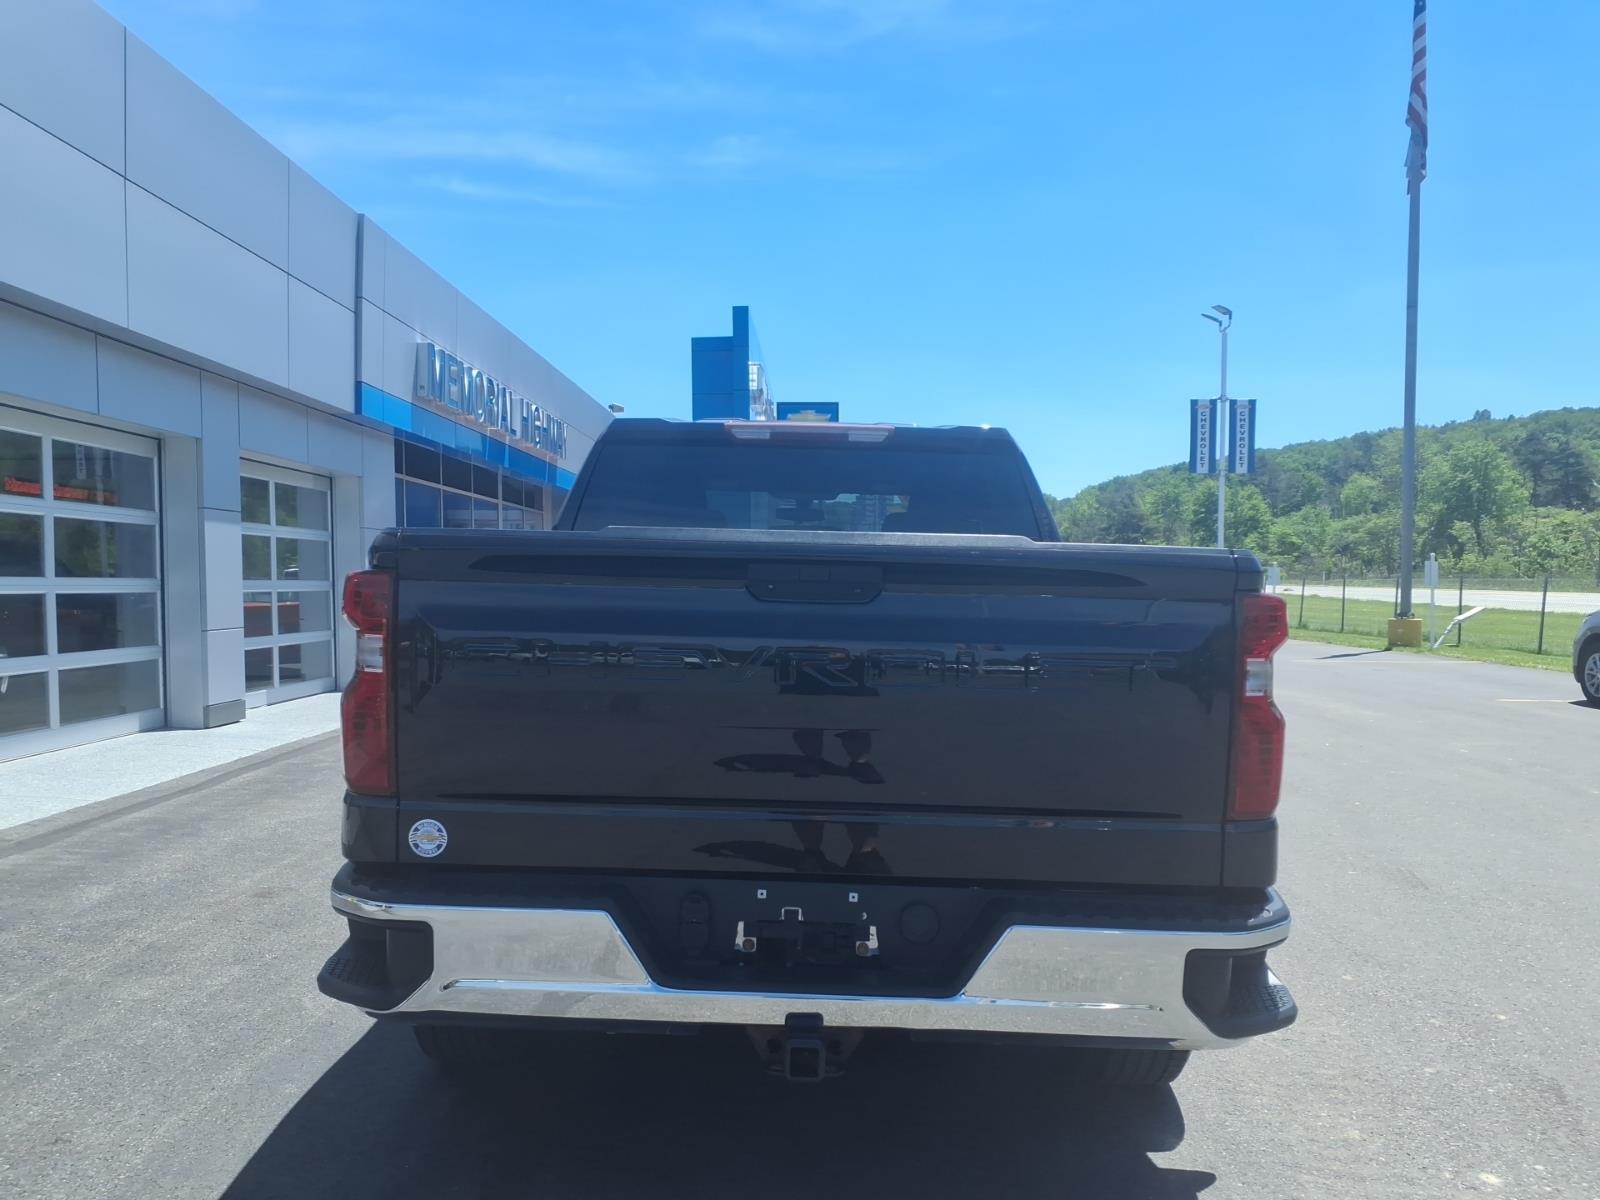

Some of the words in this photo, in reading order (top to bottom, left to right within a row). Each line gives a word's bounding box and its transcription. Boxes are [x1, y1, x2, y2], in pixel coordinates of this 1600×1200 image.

[415, 342, 521, 439] MEMORIAL
[520, 397, 569, 460] HIGHWAY
[1200, 410, 1208, 469] CHEVROLET
[1239, 410, 1247, 469] CHEVROLET
